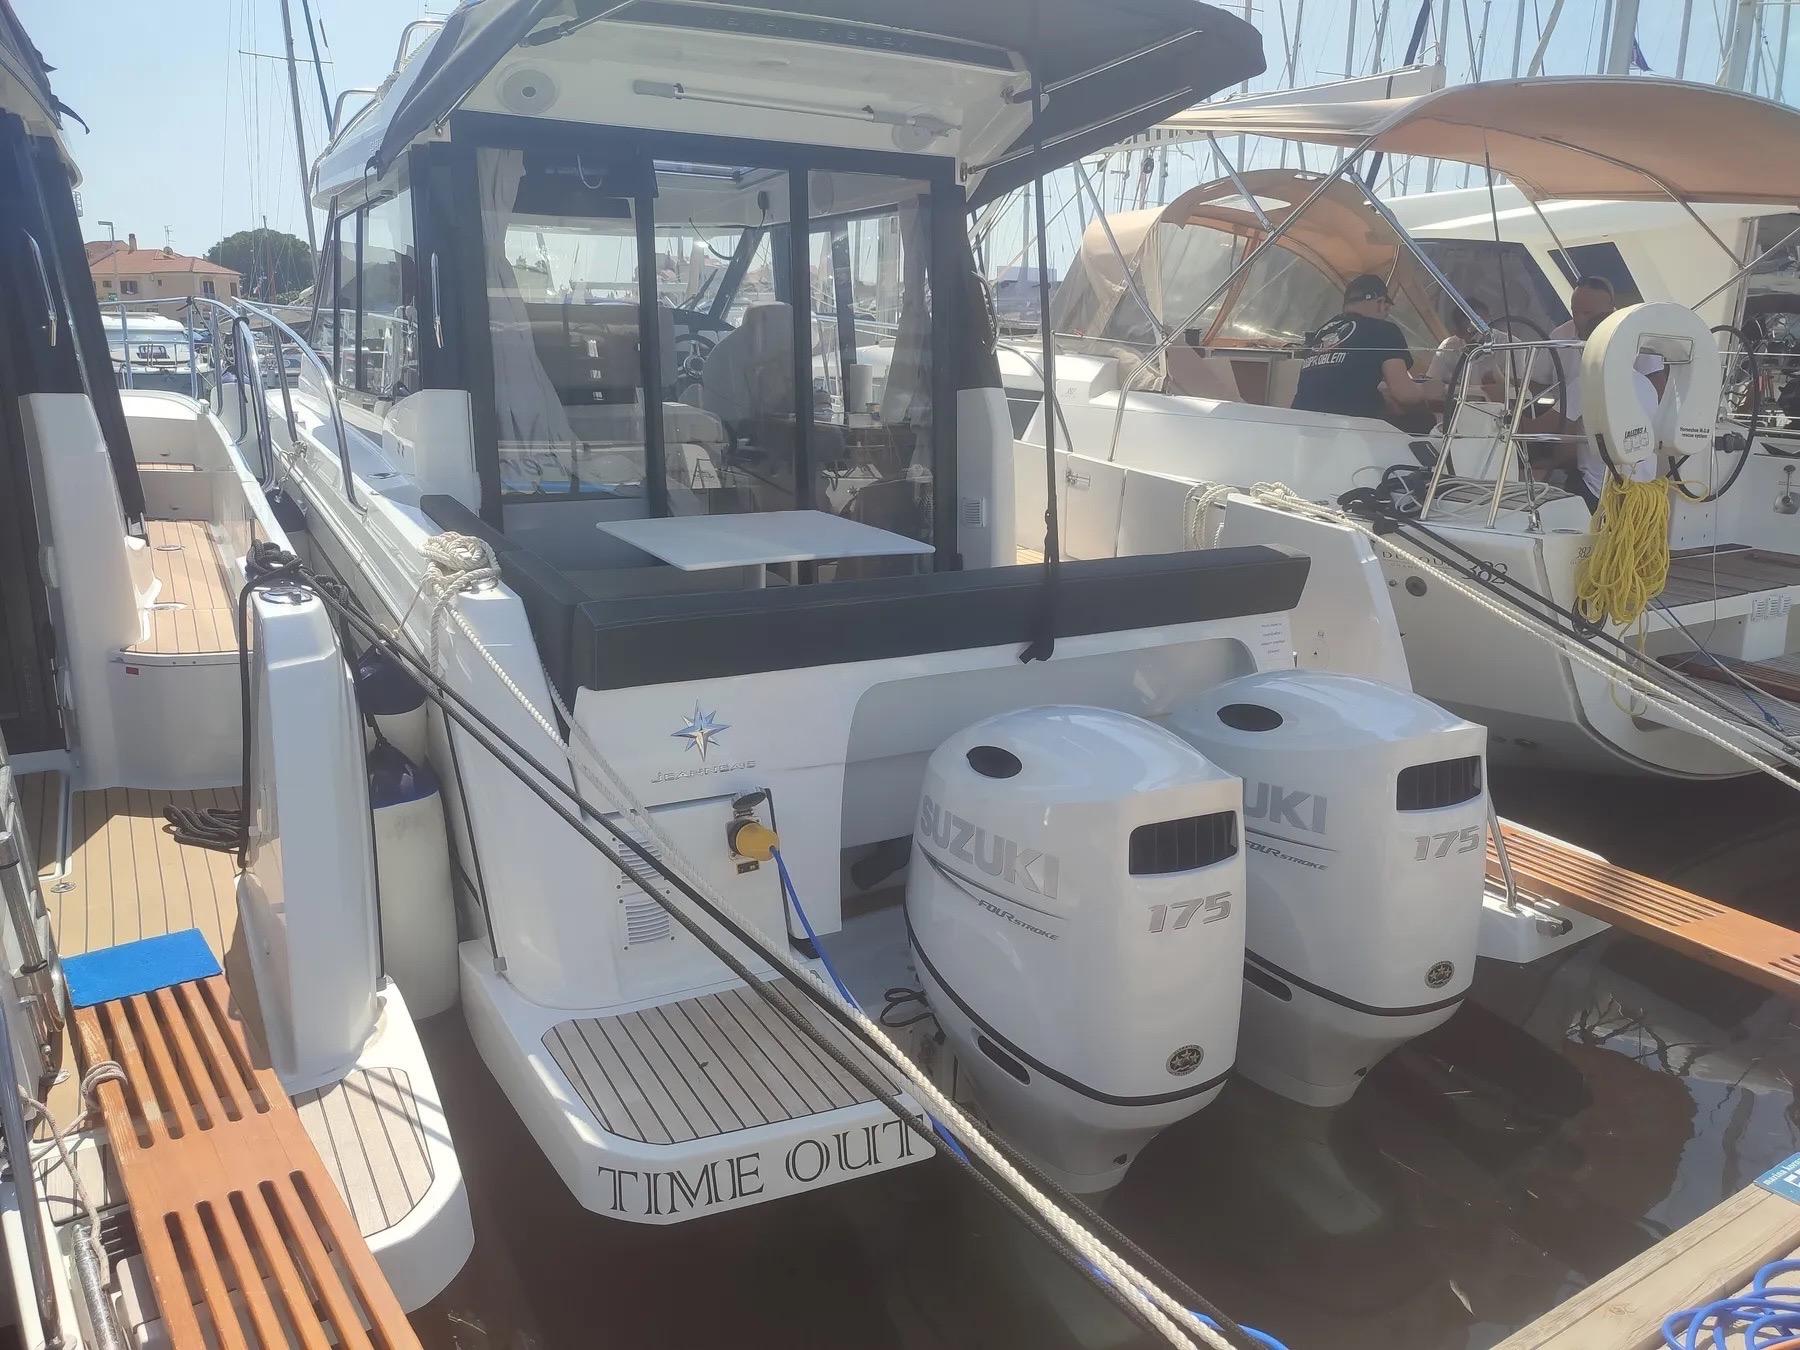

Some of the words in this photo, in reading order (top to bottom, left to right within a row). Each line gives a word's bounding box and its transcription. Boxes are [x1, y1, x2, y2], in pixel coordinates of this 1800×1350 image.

[1243, 782, 1328, 836] UKI
[920, 795, 1060, 900] SUZUKI
[1413, 825, 1480, 861] 175
[1148, 891, 1232, 934] 175
[598, 1152, 764, 1215] TIME
[785, 1114, 925, 1182] OUT
